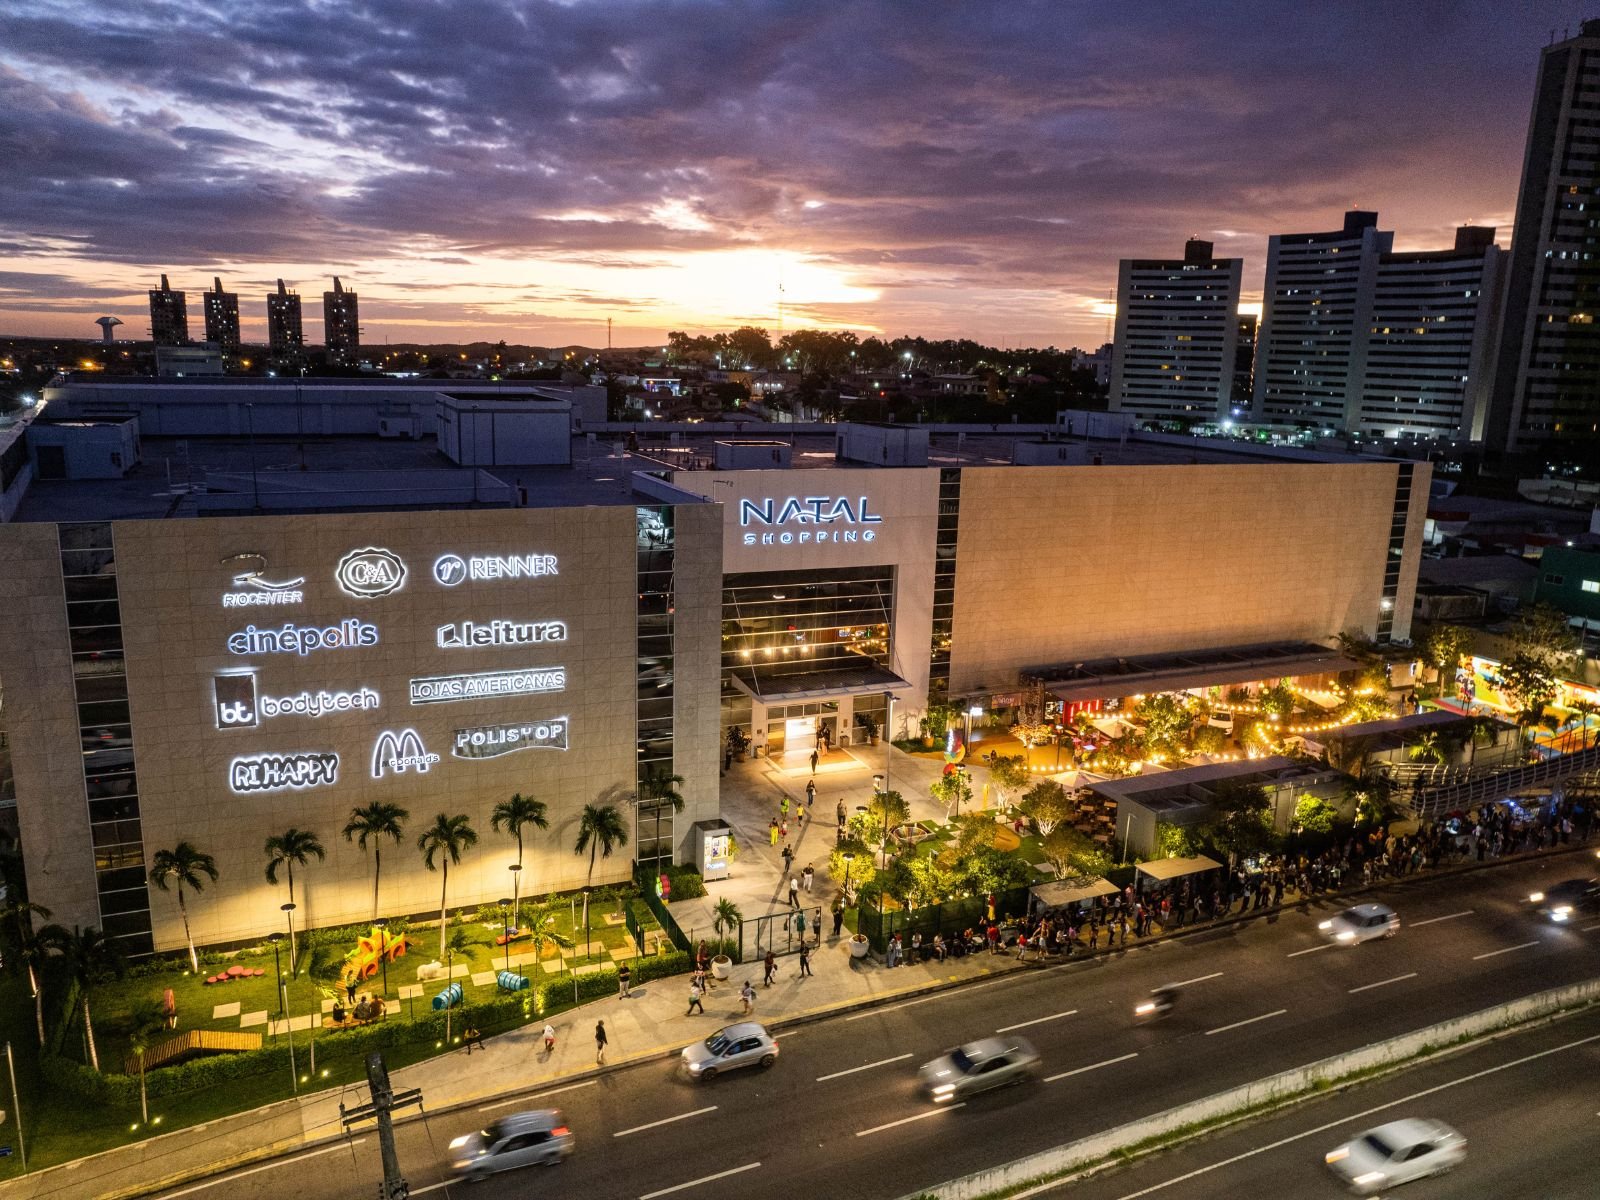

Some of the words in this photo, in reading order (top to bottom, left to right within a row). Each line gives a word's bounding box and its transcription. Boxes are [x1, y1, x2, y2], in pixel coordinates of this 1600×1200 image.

[740, 496, 882, 525] NATAL
[743, 530, 875, 545] SHOPPING
[348, 560, 396, 584] C&A
[470, 554, 558, 579] RENNER
[223, 590, 303, 607] RIOCENTER
[228, 618, 377, 655] cinépolis
[463, 620, 566, 647] leitura
[411, 683, 462, 698] LOJAS
[464, 673, 565, 695] AMERICANAS
[220, 701, 252, 723] bt
[261, 688, 380, 717] bodytech
[457, 725, 563, 747] POLISHOP
[235, 765, 260, 787] RI
[262, 759, 336, 785] HAPPY
